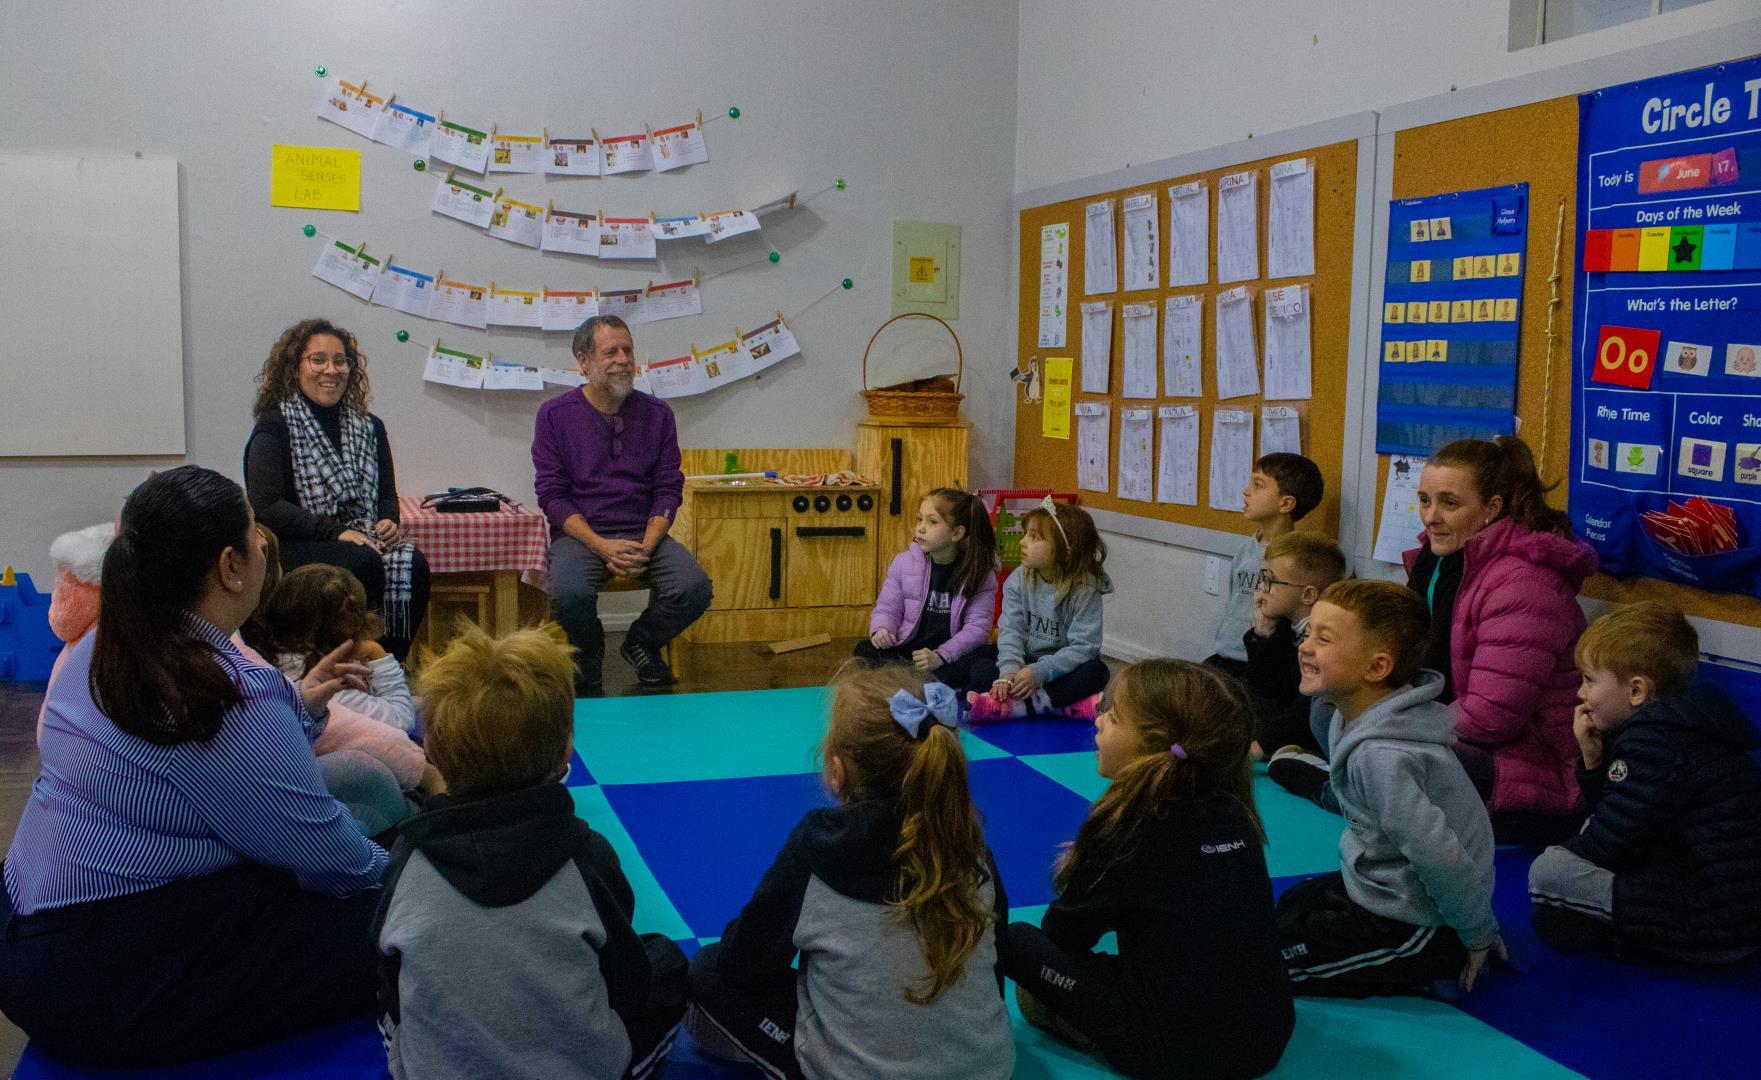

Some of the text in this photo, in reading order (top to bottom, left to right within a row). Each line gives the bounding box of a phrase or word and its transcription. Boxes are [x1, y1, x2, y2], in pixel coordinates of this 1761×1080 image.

[1642, 82, 1731, 134] Circle
[285, 152, 342, 169] ANIMAL
[300, 169, 346, 185] SENSES
[1598, 170, 1634, 188] Tody is
[1676, 168, 1700, 180] June
[294, 187, 322, 201] LAB
[1636, 201, 1742, 225] Days of the Week
[1627, 296, 1738, 312] What's the Letter?
[1600, 336, 1649, 374] Oo
[1596, 405, 1650, 422] Rhye Time
[1689, 411, 1723, 425] Color
[1687, 466, 1713, 477] square
[1740, 472, 1758, 482] purple
[1215, 839, 1246, 853] IENH
[758, 1017, 791, 1044] IENH
